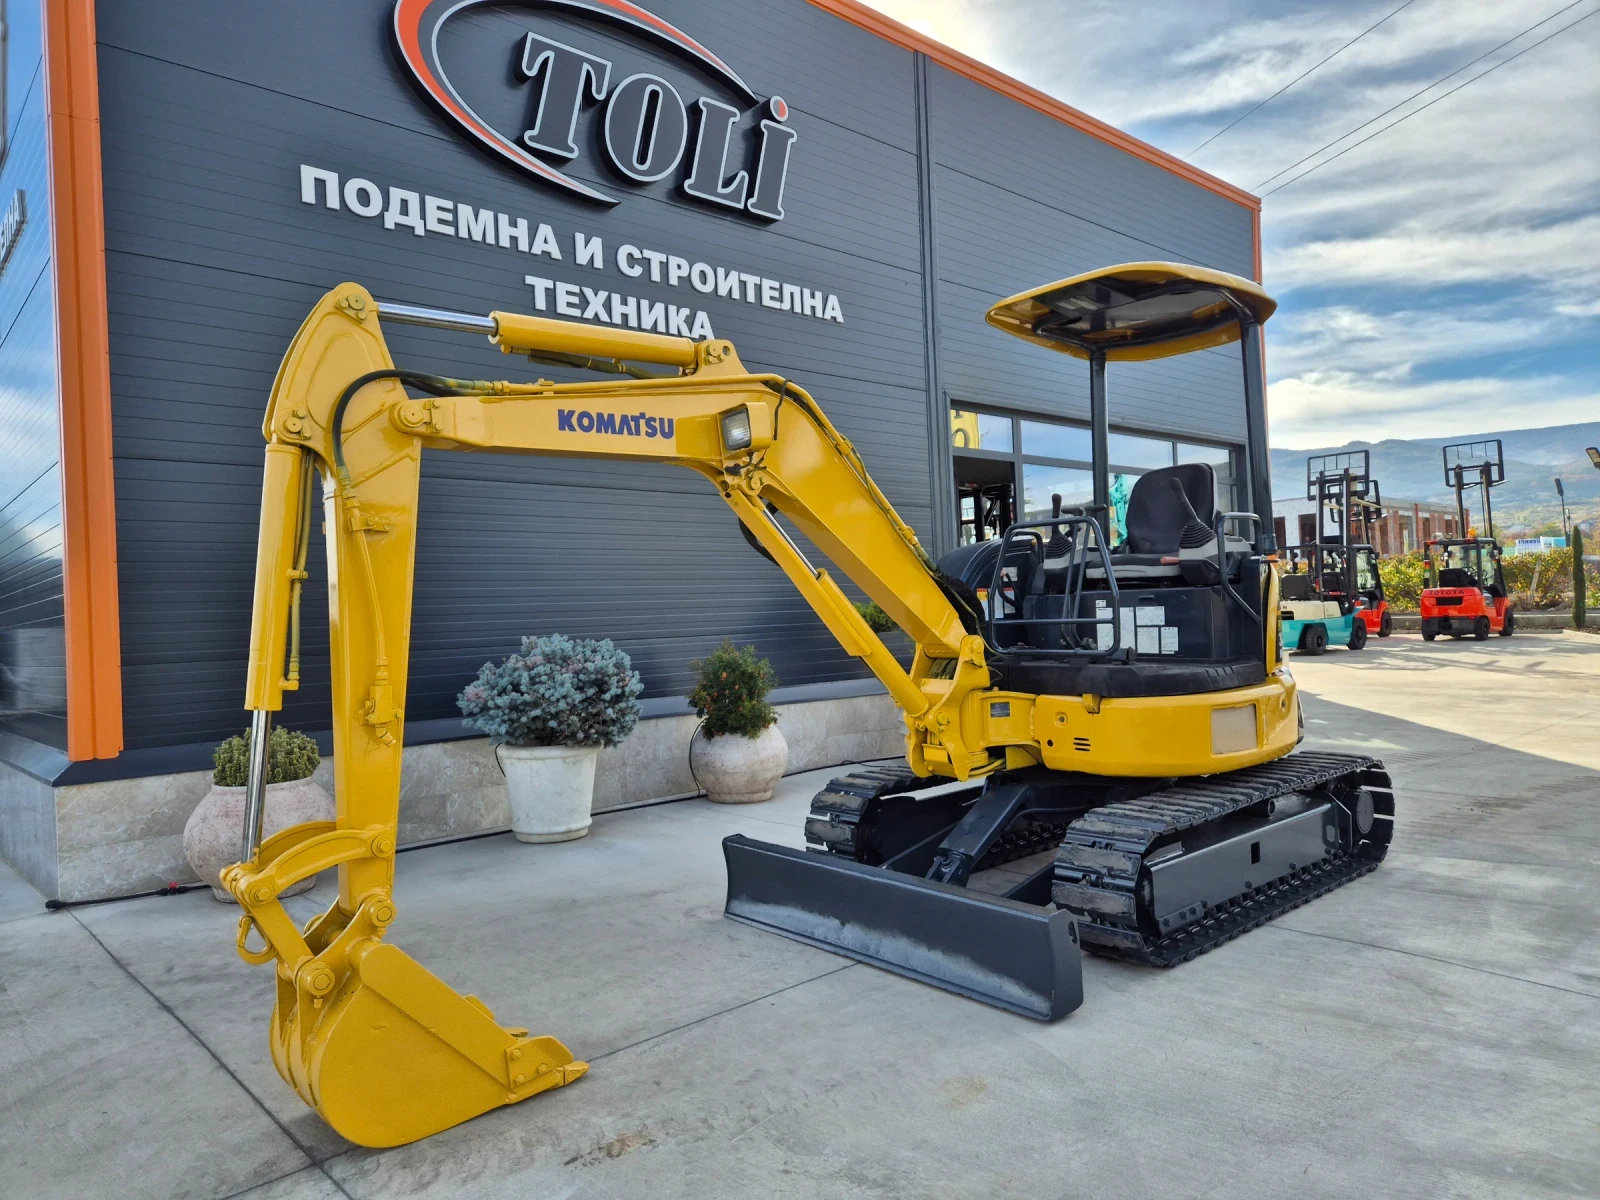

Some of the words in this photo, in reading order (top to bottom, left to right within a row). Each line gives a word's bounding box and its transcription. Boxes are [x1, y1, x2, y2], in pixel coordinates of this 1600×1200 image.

[300, 164, 562, 260] ПОДЕМНА
[574, 232, 604, 269] И
[616, 244, 844, 323] СТРОИТЕЛНА
[524, 275, 715, 340] ТЕХНИКА
[558, 409, 674, 439] KOMATSU
